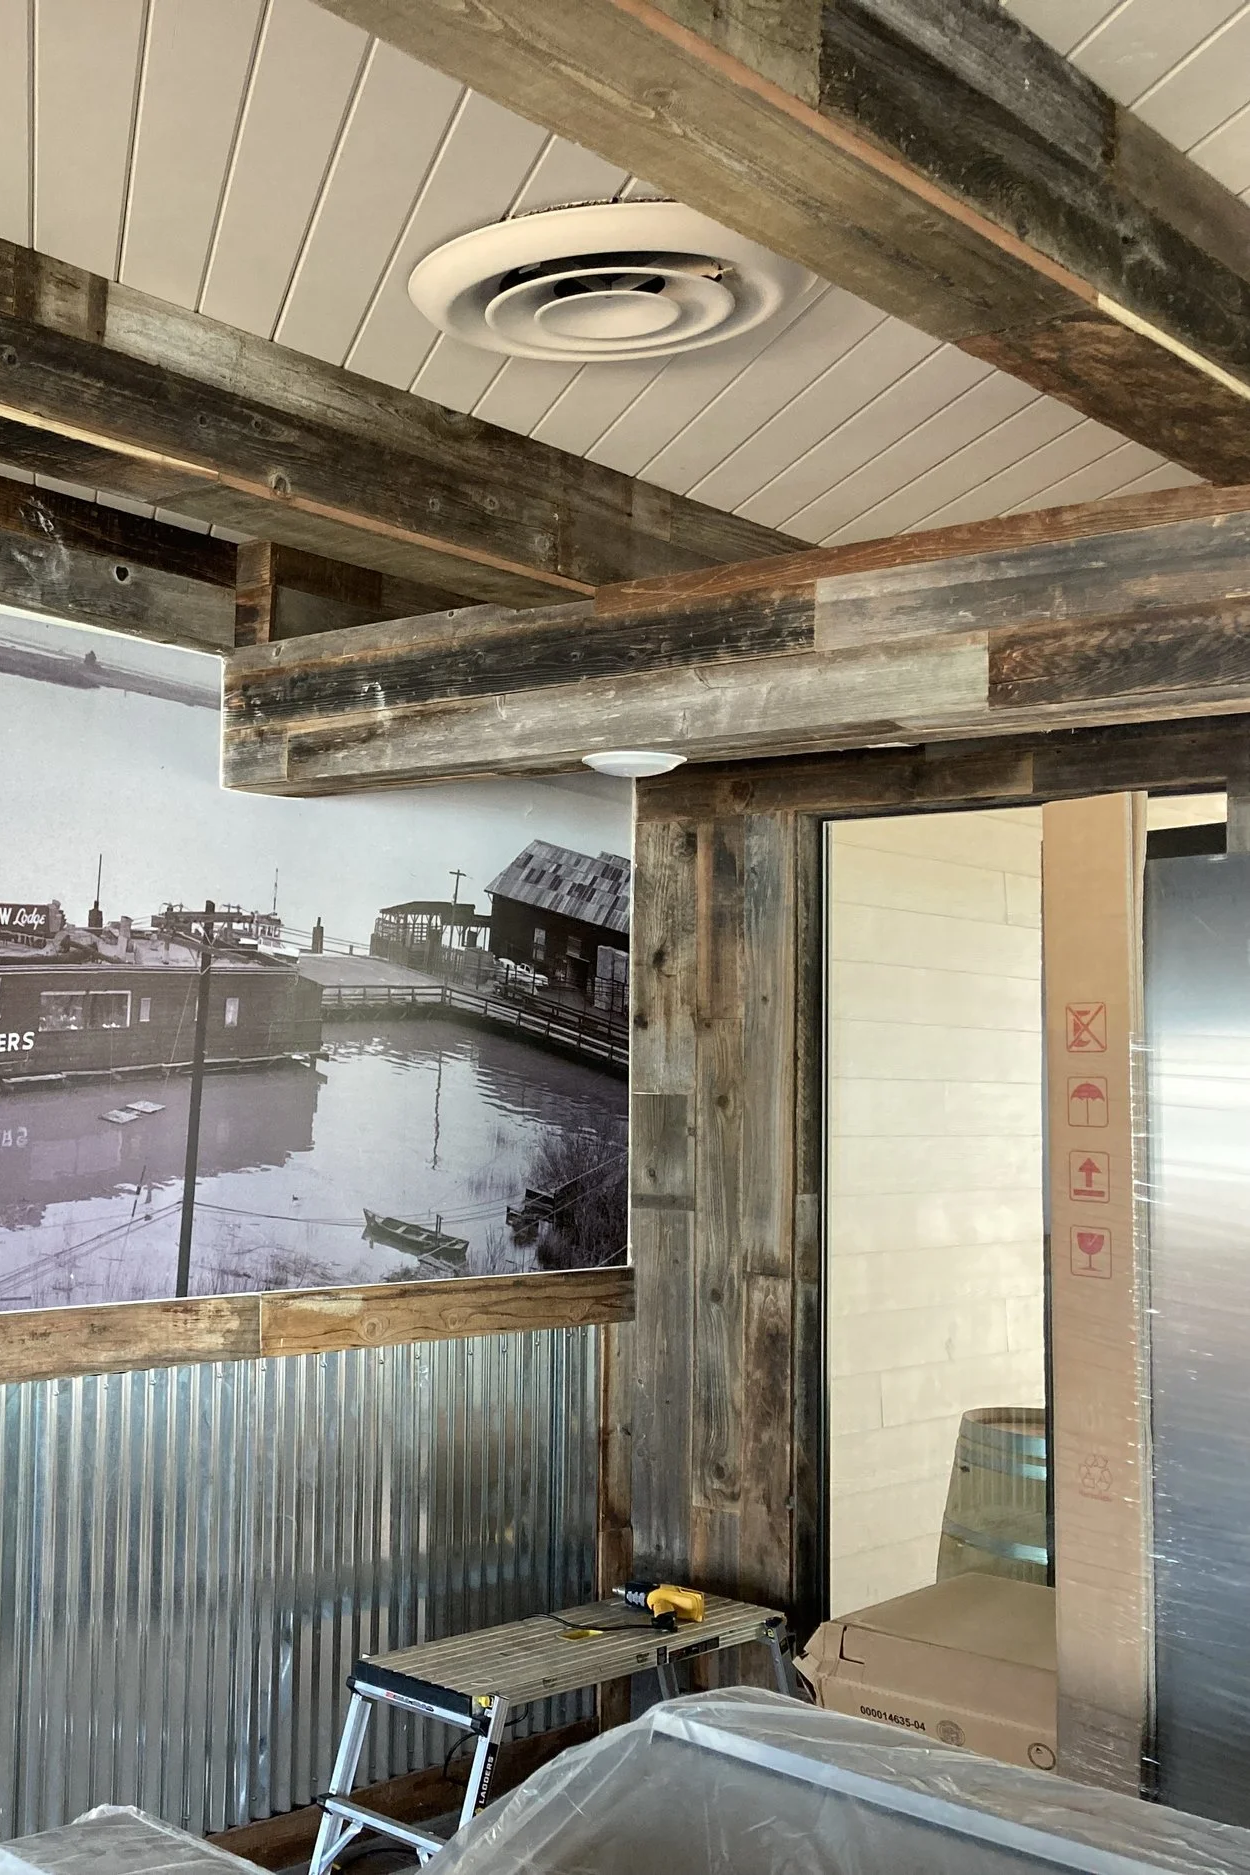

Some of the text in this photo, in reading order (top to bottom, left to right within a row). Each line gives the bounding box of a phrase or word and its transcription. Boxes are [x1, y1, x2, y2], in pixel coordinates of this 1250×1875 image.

[12, 910, 47, 927] Lodge
[859, 1705, 926, 1732] 000014635-04
[478, 1756, 494, 1804] LADDERS
